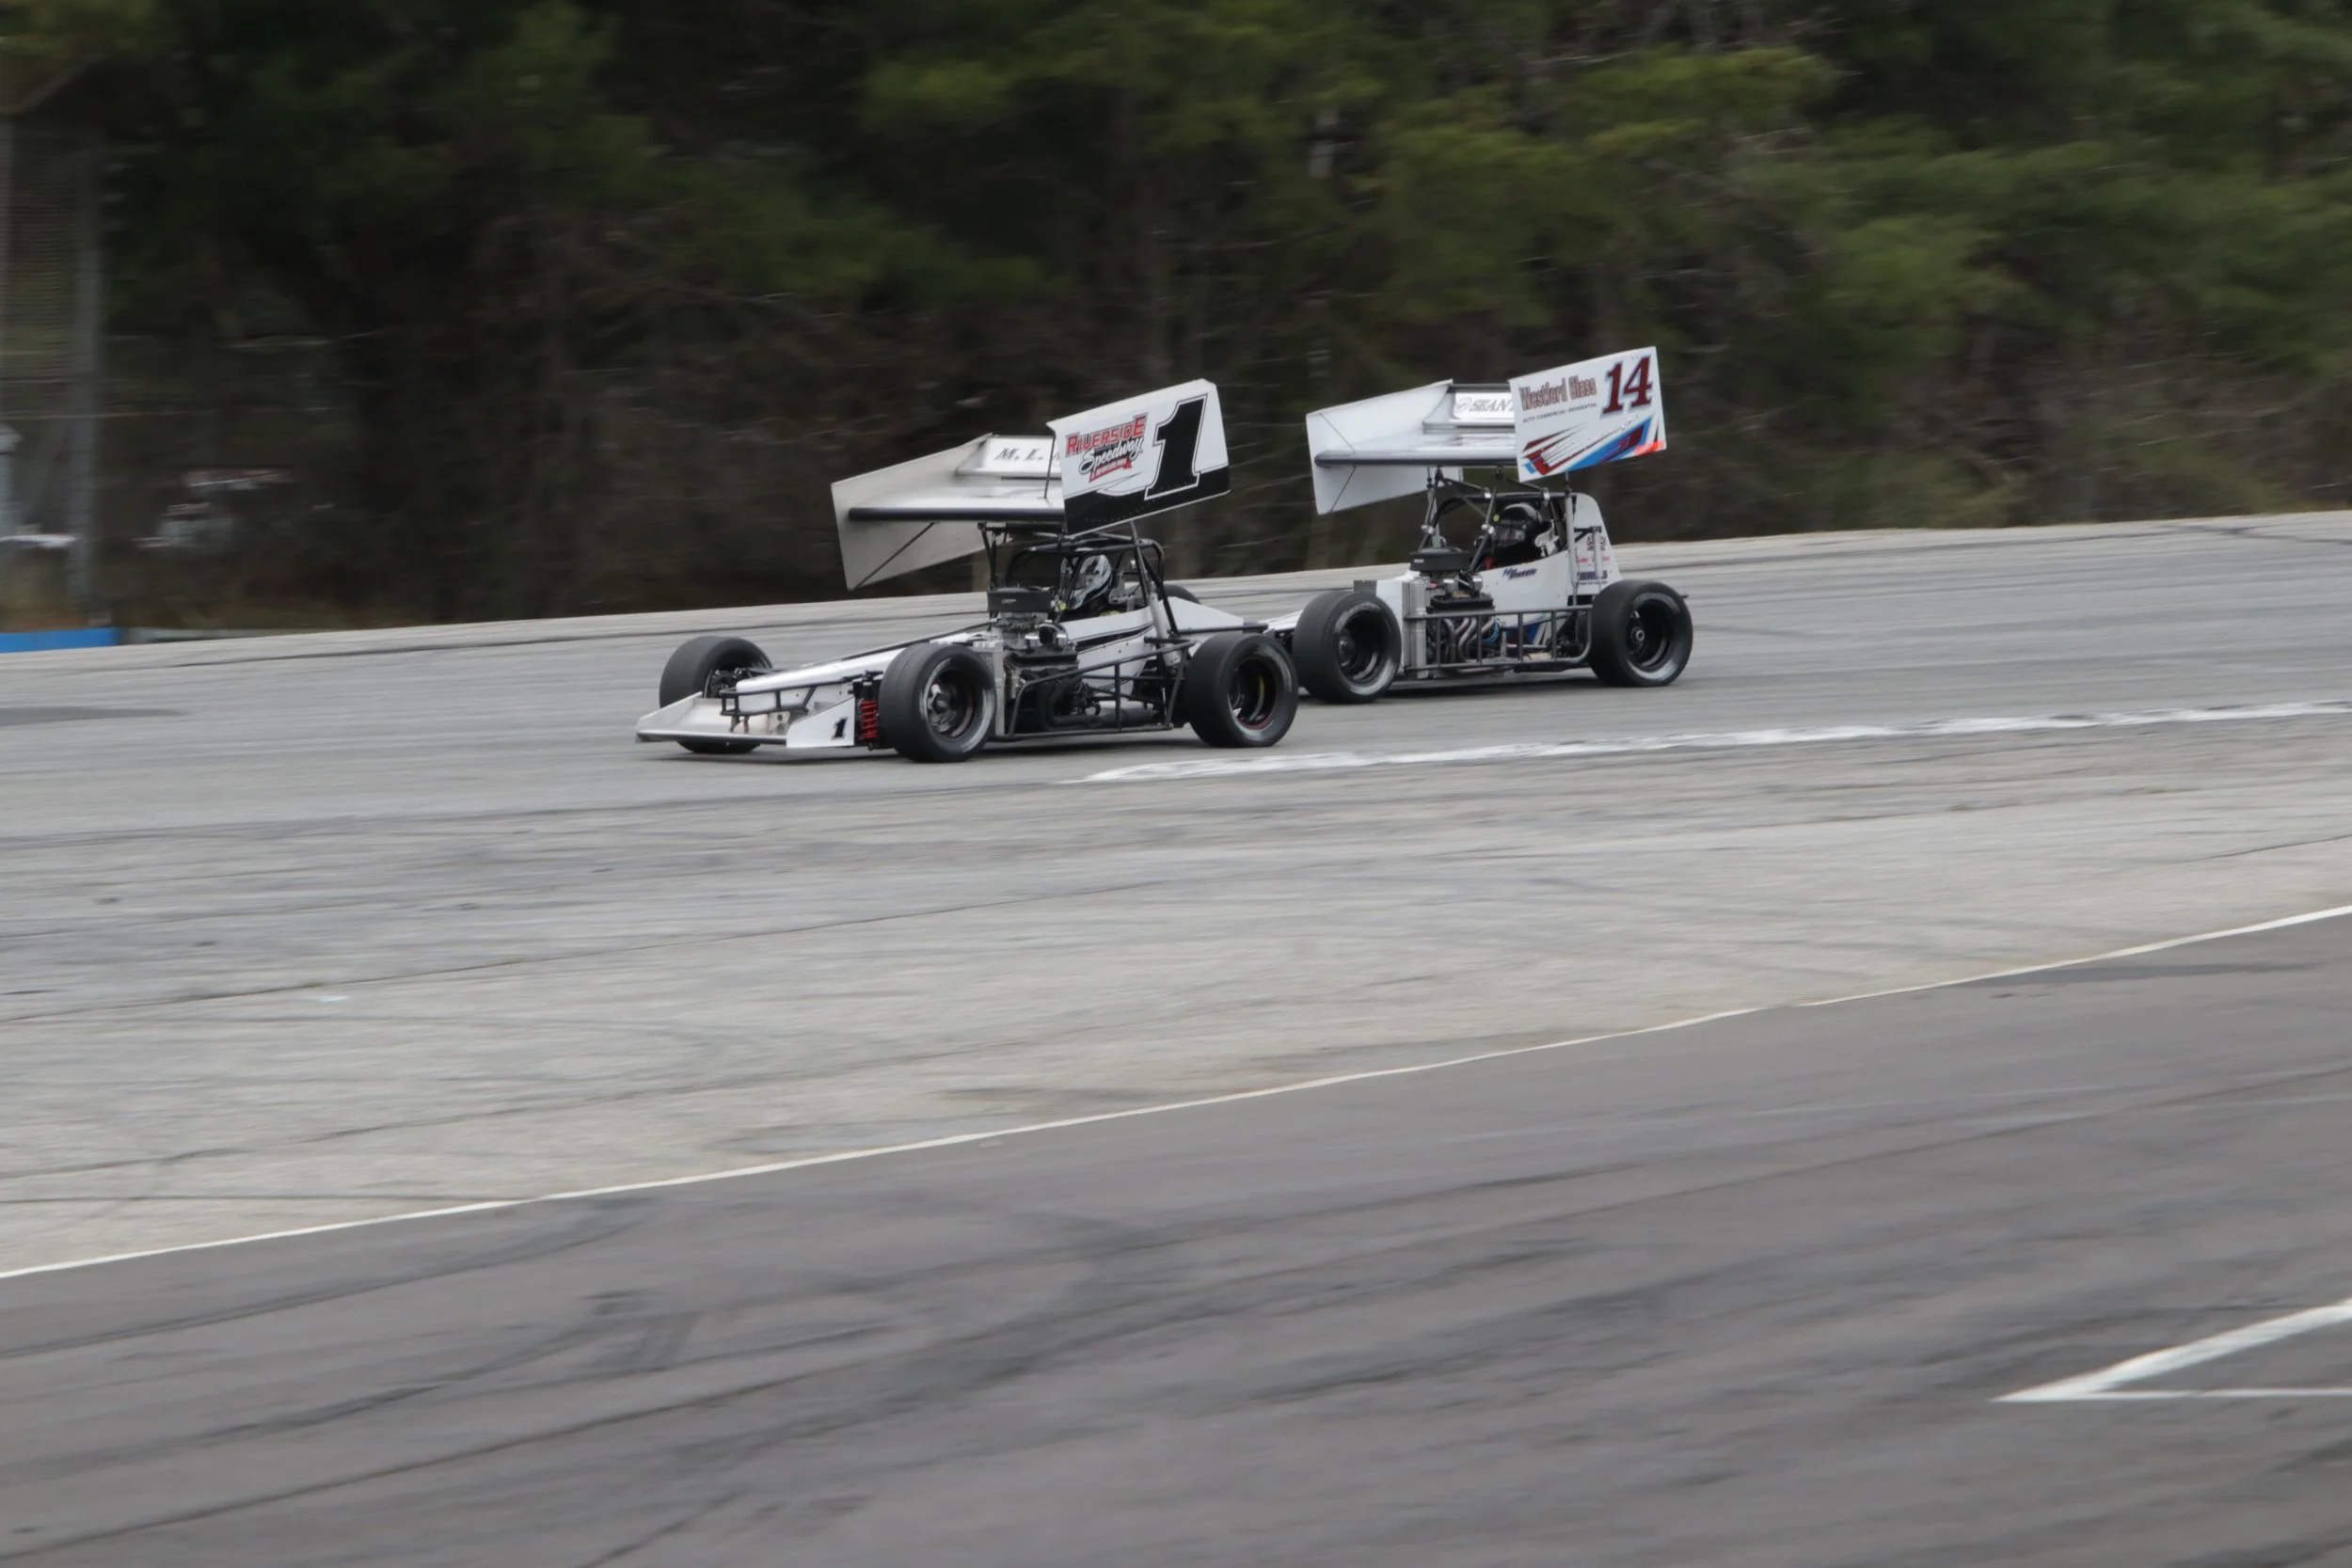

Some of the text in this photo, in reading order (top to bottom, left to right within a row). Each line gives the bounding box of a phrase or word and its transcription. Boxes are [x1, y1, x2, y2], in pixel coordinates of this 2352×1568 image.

[1518, 375, 1597, 411] Westford Glass
[1601, 355, 1653, 415] 14
[1065, 413, 1148, 458] RIVERSIDE
[1078, 436, 1144, 476] Speedway
[1145, 394, 1207, 500] 1
[831, 716, 849, 741] 1
